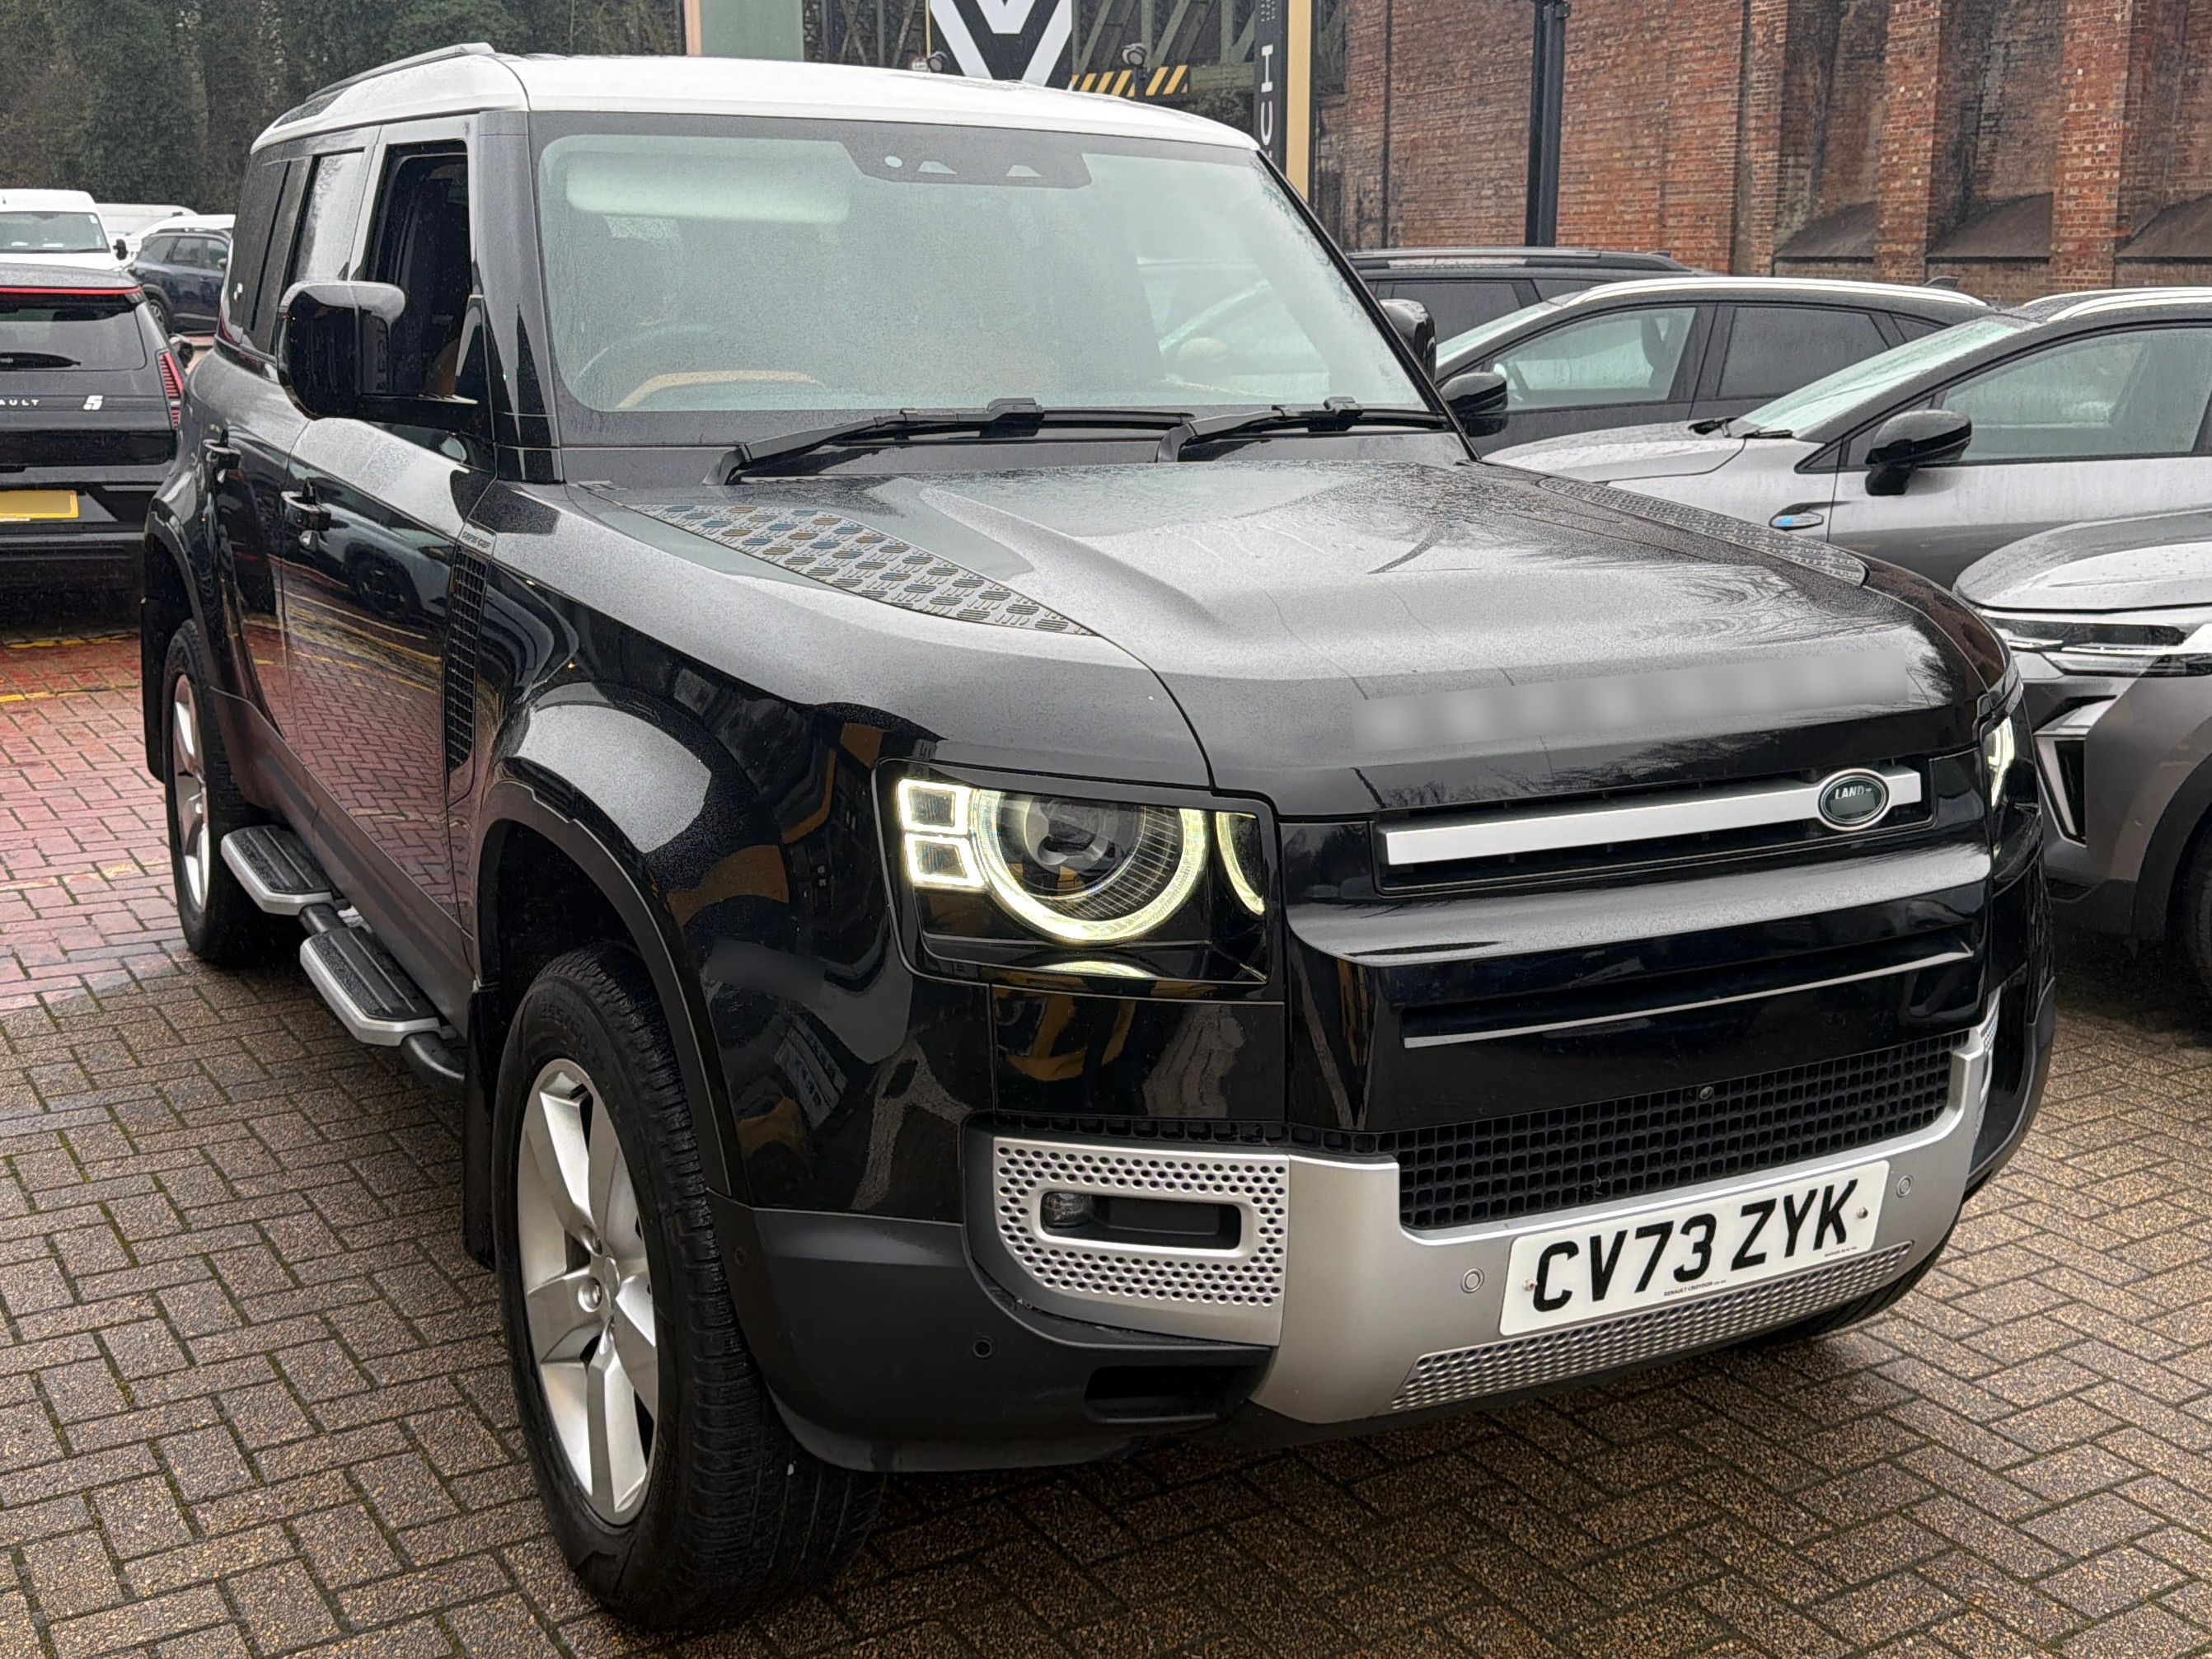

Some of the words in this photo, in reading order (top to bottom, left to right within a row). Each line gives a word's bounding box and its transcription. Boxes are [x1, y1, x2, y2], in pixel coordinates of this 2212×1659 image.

[1835, 785, 1865, 799] LAND
[1533, 1212, 1717, 1312] CV73
[1731, 1179, 1858, 1272] ZYK
[1664, 1286, 1687, 1296] RENAULT
